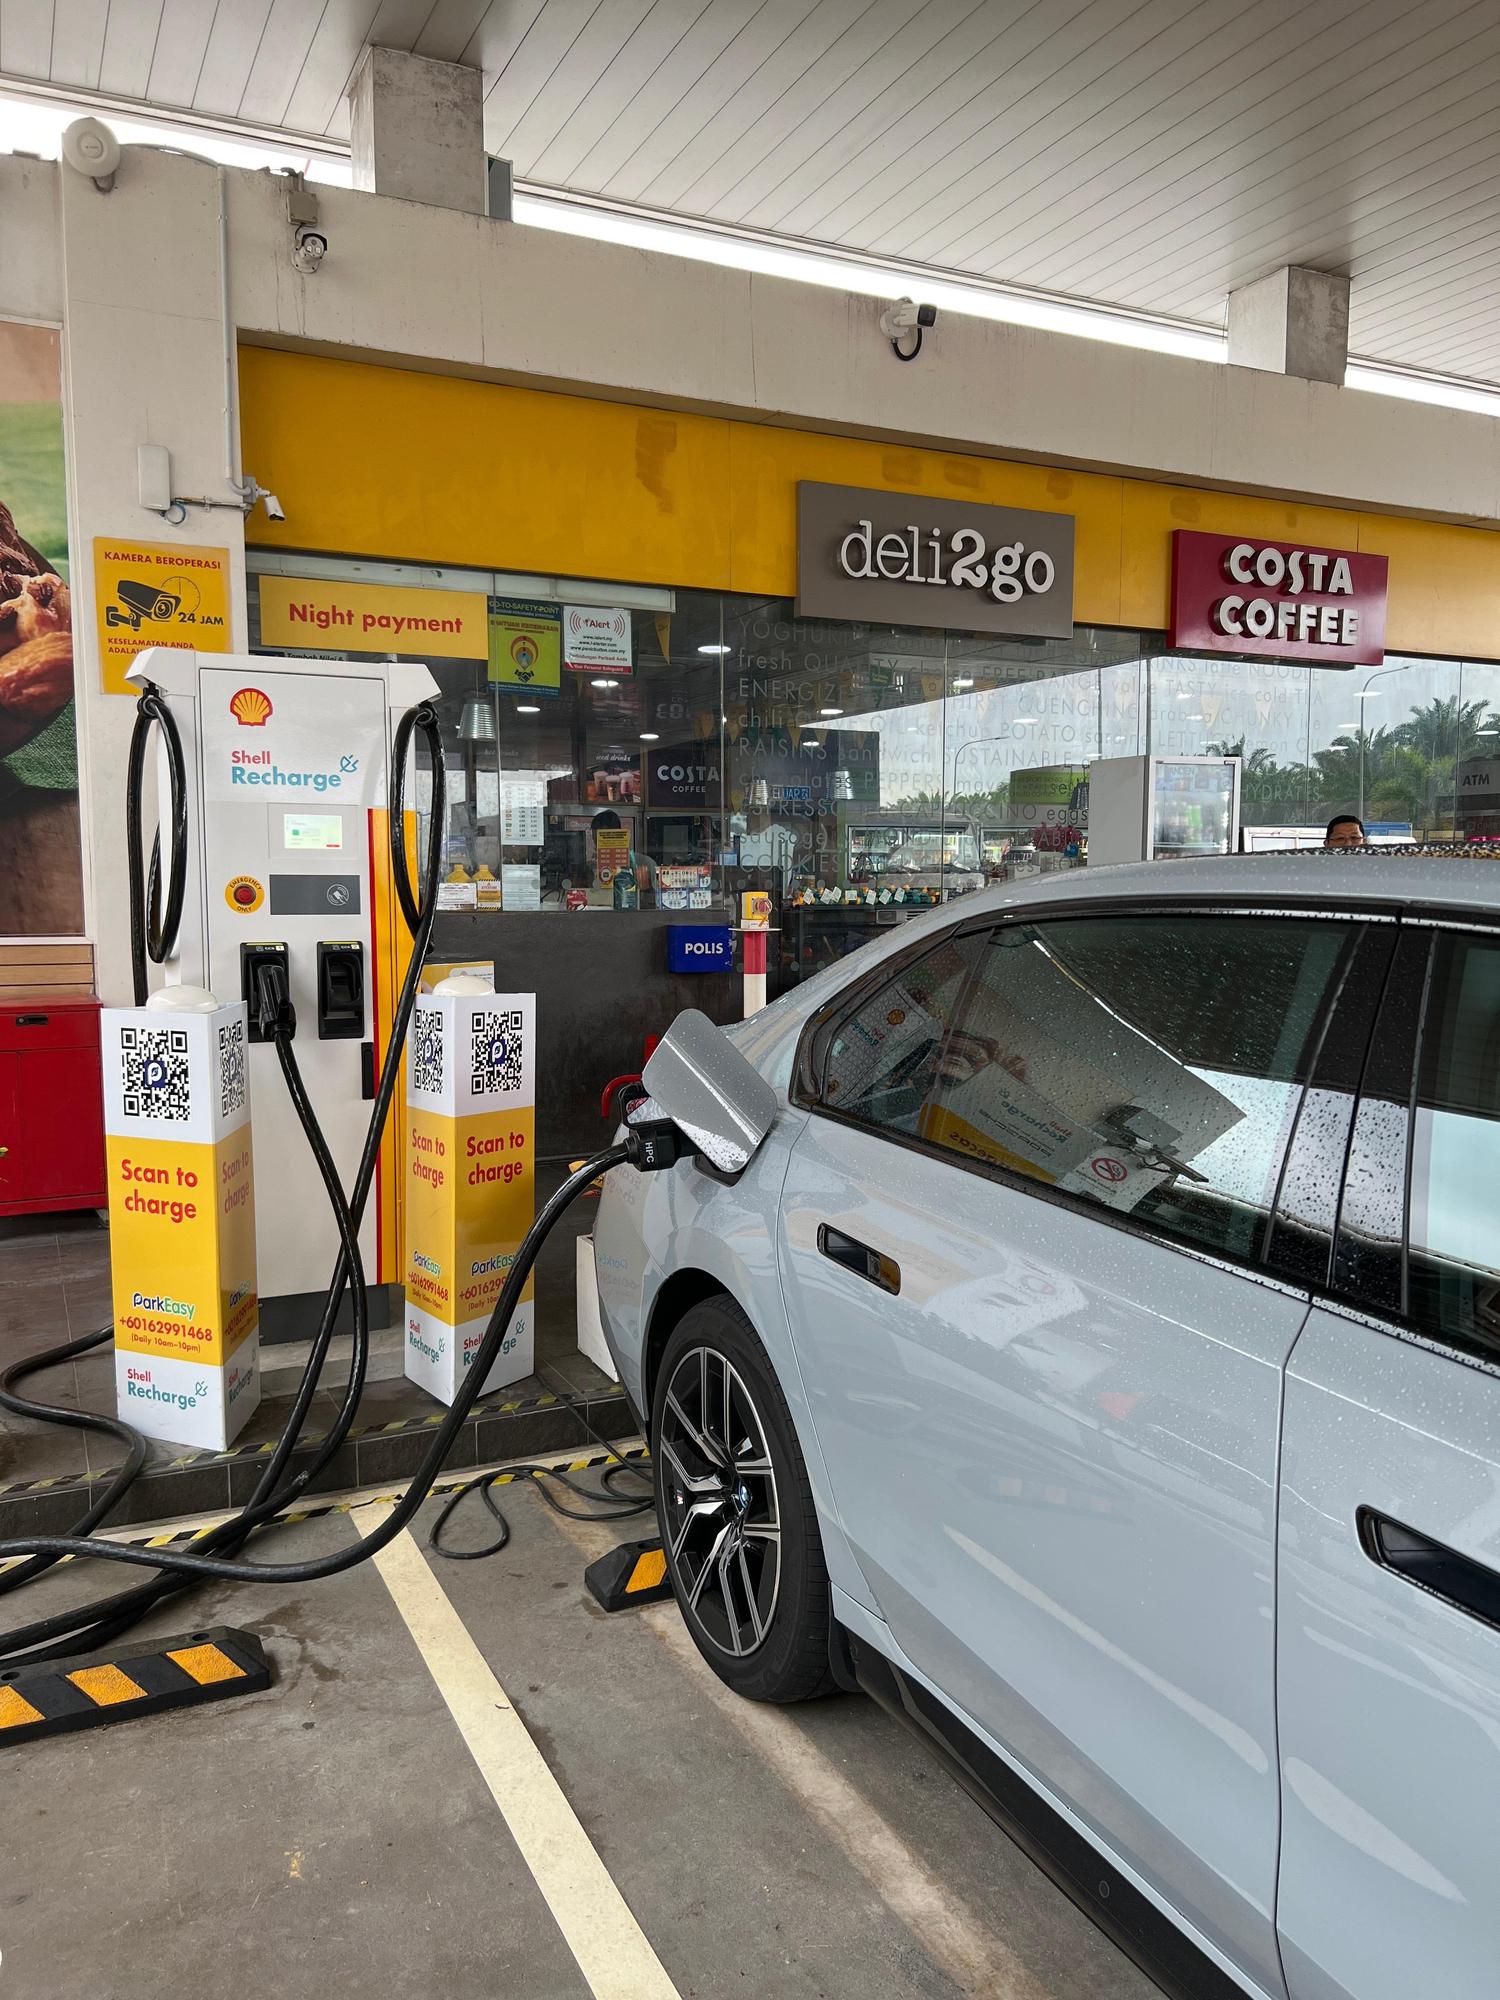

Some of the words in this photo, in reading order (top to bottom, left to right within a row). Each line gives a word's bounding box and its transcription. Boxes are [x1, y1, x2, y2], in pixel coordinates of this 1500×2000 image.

[104, 552, 152, 563] KAMERA
[155, 556, 221, 569] BEROPERASI
[841, 520, 1055, 602] deli2go
[1227, 543, 1354, 595] COSTA
[178, 612, 196, 623] 24
[200, 616, 224, 626] JAM
[289, 603, 354, 629] Night
[362, 613, 463, 634] payment
[1217, 595, 1359, 645] COFFEE
[108, 638, 168, 648] KESELAMATAN
[738, 649, 791, 670] fresh
[1255, 686, 1287, 703] cold
[738, 707, 783, 730] chili
[1001, 720, 1076, 743] POTATO
[231, 750, 271, 764] Shell
[739, 738, 827, 760] RAISINS
[231, 766, 341, 792] Recharge
[656, 765, 720, 783] COSTA
[1462, 774, 1490, 786] ATM
[672, 785, 706, 793] COFFEE
[1047, 808, 1088, 825] eggs
[740, 852, 841, 873] COOKIES
[229, 875, 262, 890] EMERGENCY
[685, 942, 724, 955] POLIS
[412, 1128, 432, 1153] Scan
[436, 1137, 445, 1156] to
[467, 1136, 504, 1157] Scan
[509, 1131, 525, 1149] to
[645, 1141, 655, 1163] HPC
[121, 1159, 169, 1184] Scan
[176, 1167, 198, 1187] to
[222, 1160, 241, 1184] Scan
[413, 1156, 444, 1189] charge
[468, 1162, 523, 1185] charge
[125, 1189, 197, 1223] charge
[224, 1181, 250, 1213] charge
[414, 1251, 441, 1279] ParkEasy
[408, 1272, 449, 1302] +60162991468
[133, 1292, 195, 1320] ParkEasy
[119, 1315, 213, 1342] +60162991468
[131, 1333, 152, 1345] (Daily
[410, 1320, 420, 1334] Shell
[410, 1331, 440, 1363] Recharge
[127, 1368, 152, 1383] Shell
[127, 1381, 197, 1410] Recharge
